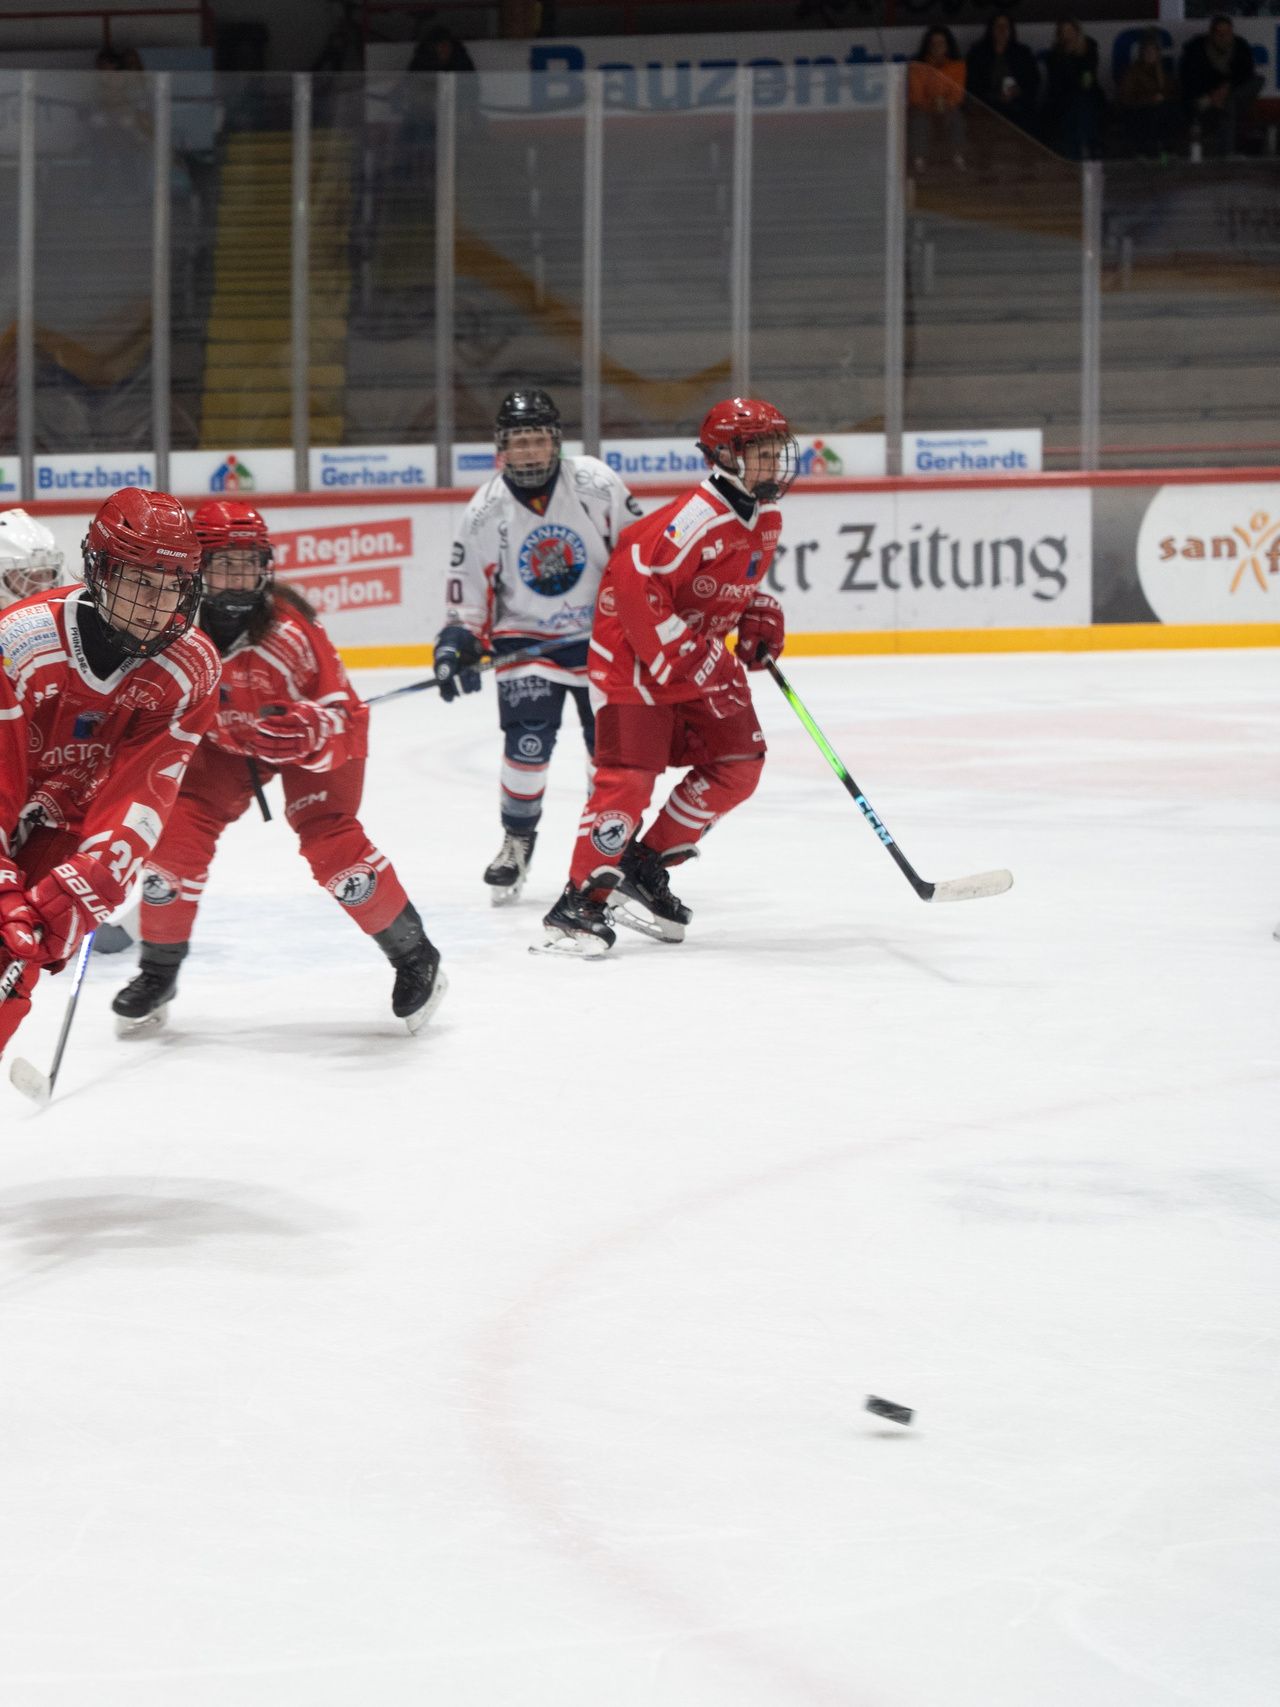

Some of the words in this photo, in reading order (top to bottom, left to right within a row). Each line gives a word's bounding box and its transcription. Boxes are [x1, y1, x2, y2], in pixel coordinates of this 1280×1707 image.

[528, 42, 910, 112] Bauzent
[606, 451, 708, 472] Butzba
[916, 450, 1028, 472] Gerhardt
[38, 465, 152, 489] Butzbach
[321, 465, 425, 486] Gerhardt
[96, 520, 110, 539] BAUER
[156, 548, 188, 559] BAUER
[296, 529, 404, 565] Region.
[838, 523, 1068, 601] Zeitung
[693, 636, 724, 686] BAUE
[286, 791, 328, 817] CCM
[54, 863, 112, 923] BAUE
